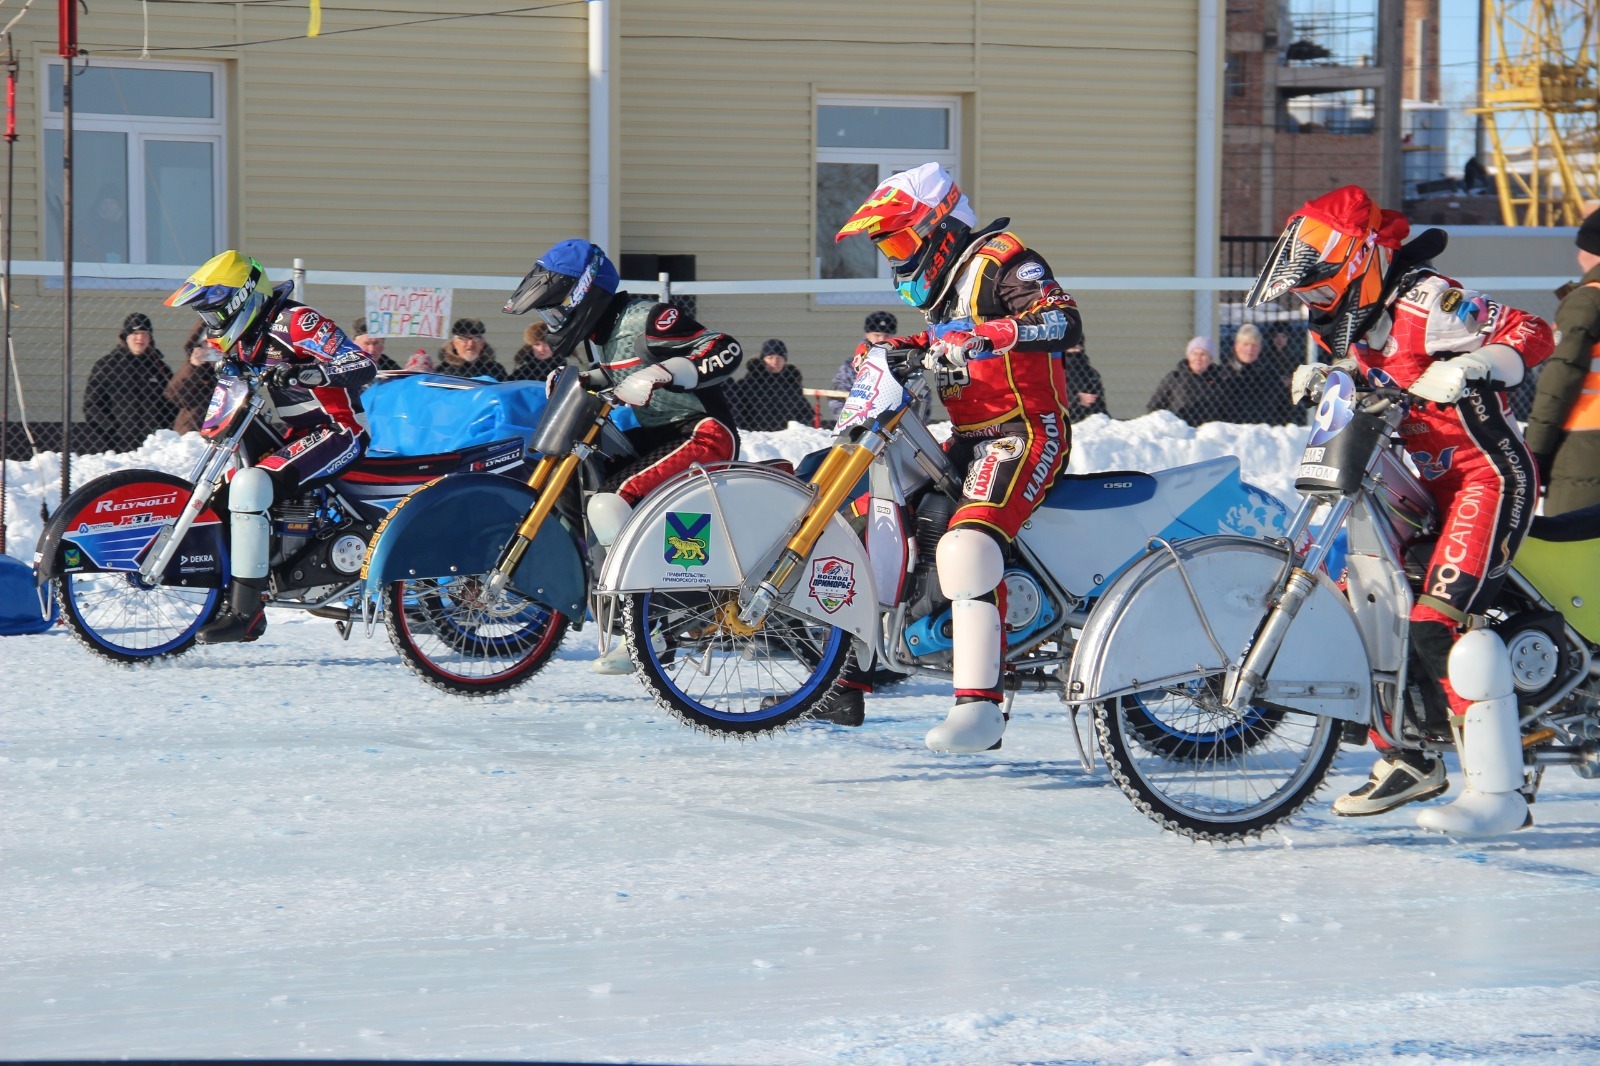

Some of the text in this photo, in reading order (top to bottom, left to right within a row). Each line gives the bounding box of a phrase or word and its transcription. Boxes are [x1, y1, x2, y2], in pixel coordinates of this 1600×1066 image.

[225, 277, 256, 315] 100%
[379, 292, 447, 313] СПАРТАК
[1041, 310, 1066, 325] ICE
[1018, 322, 1068, 341] EDWAY
[326, 451, 354, 474] WACO
[1023, 411, 1060, 503] VLADIVOOK
[95, 497, 177, 514] RELYNOLLI
[1431, 483, 1485, 600] РОСАТОМ
[190, 555, 214, 563] DEKRA
[812, 579, 852, 589] ПРИМОРЬЕ
